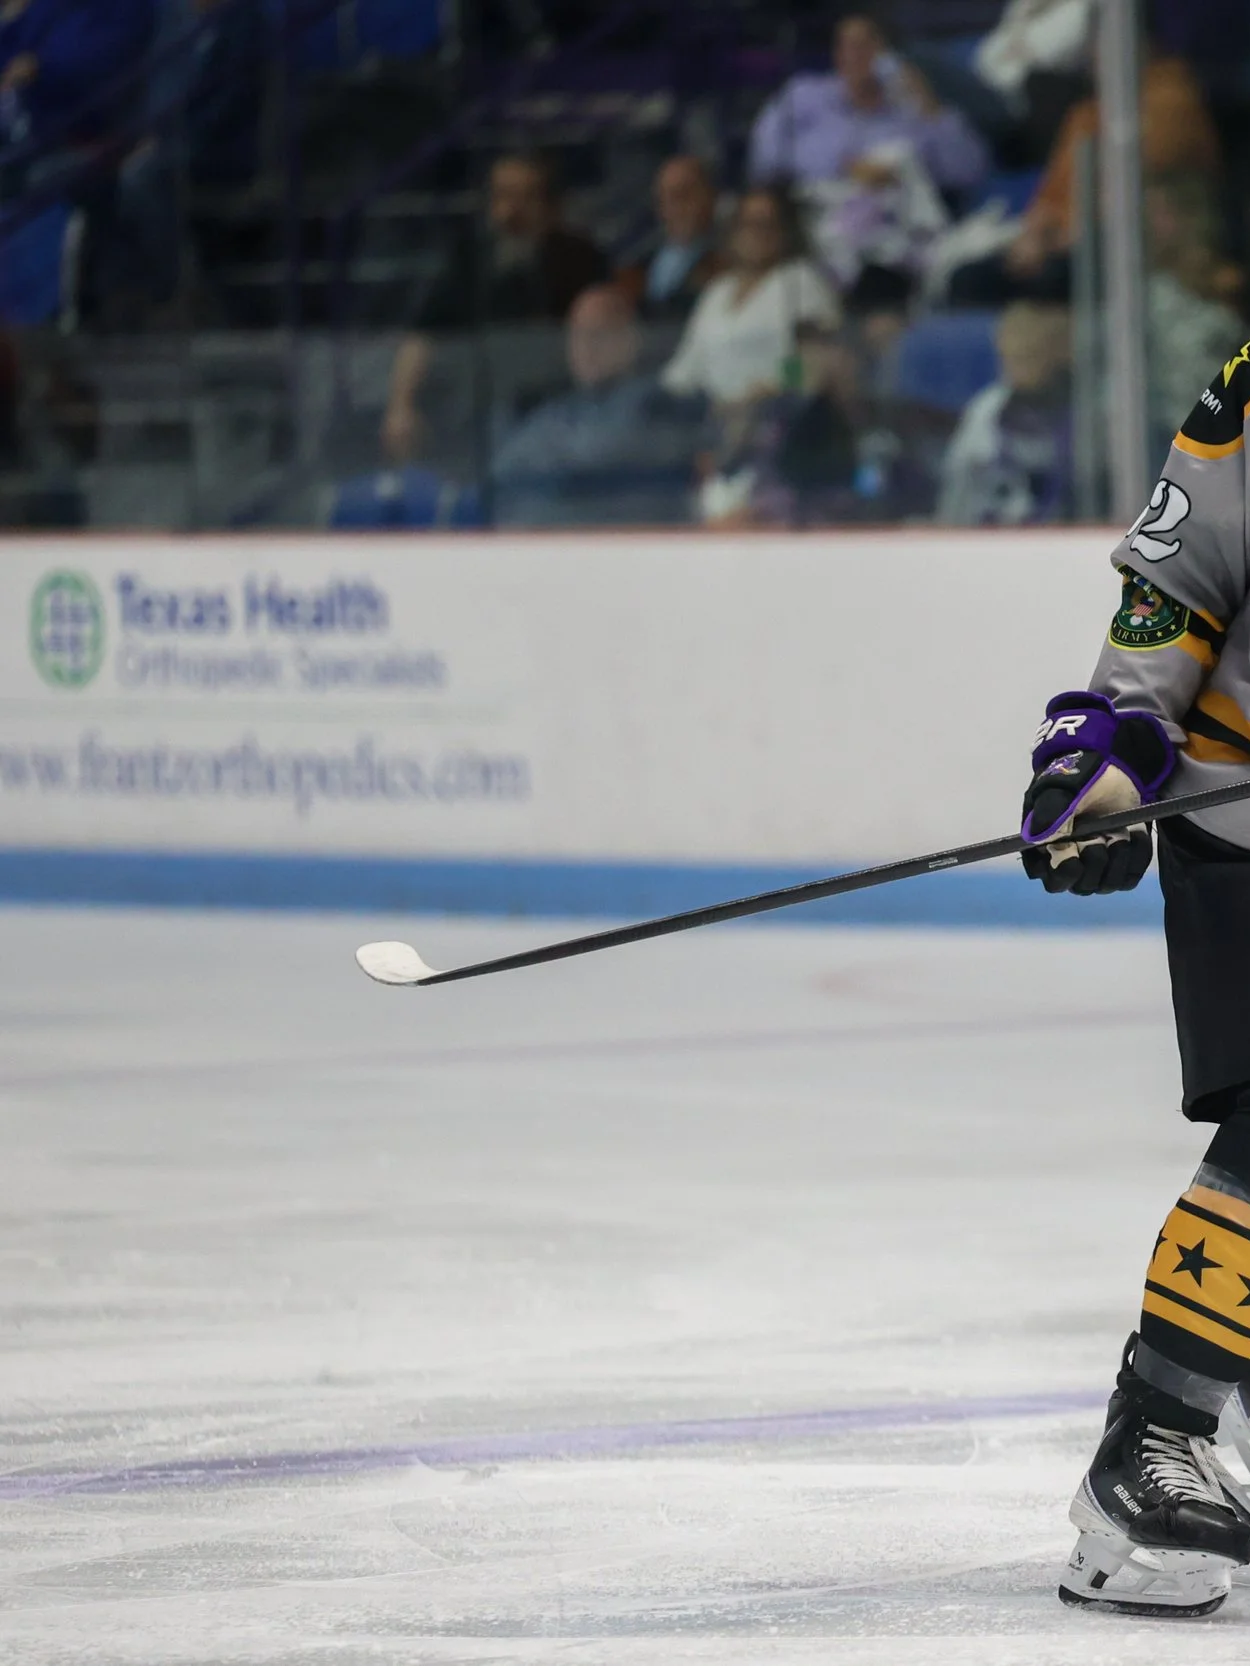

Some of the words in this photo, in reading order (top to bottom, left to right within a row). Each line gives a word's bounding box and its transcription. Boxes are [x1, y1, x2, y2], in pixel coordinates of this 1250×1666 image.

[1200, 387, 1223, 415] RMY
[1124, 477, 1192, 564] 2
[116, 571, 232, 634] Texas
[244, 571, 391, 635] Health
[1112, 1483, 1143, 1516] BAUER
